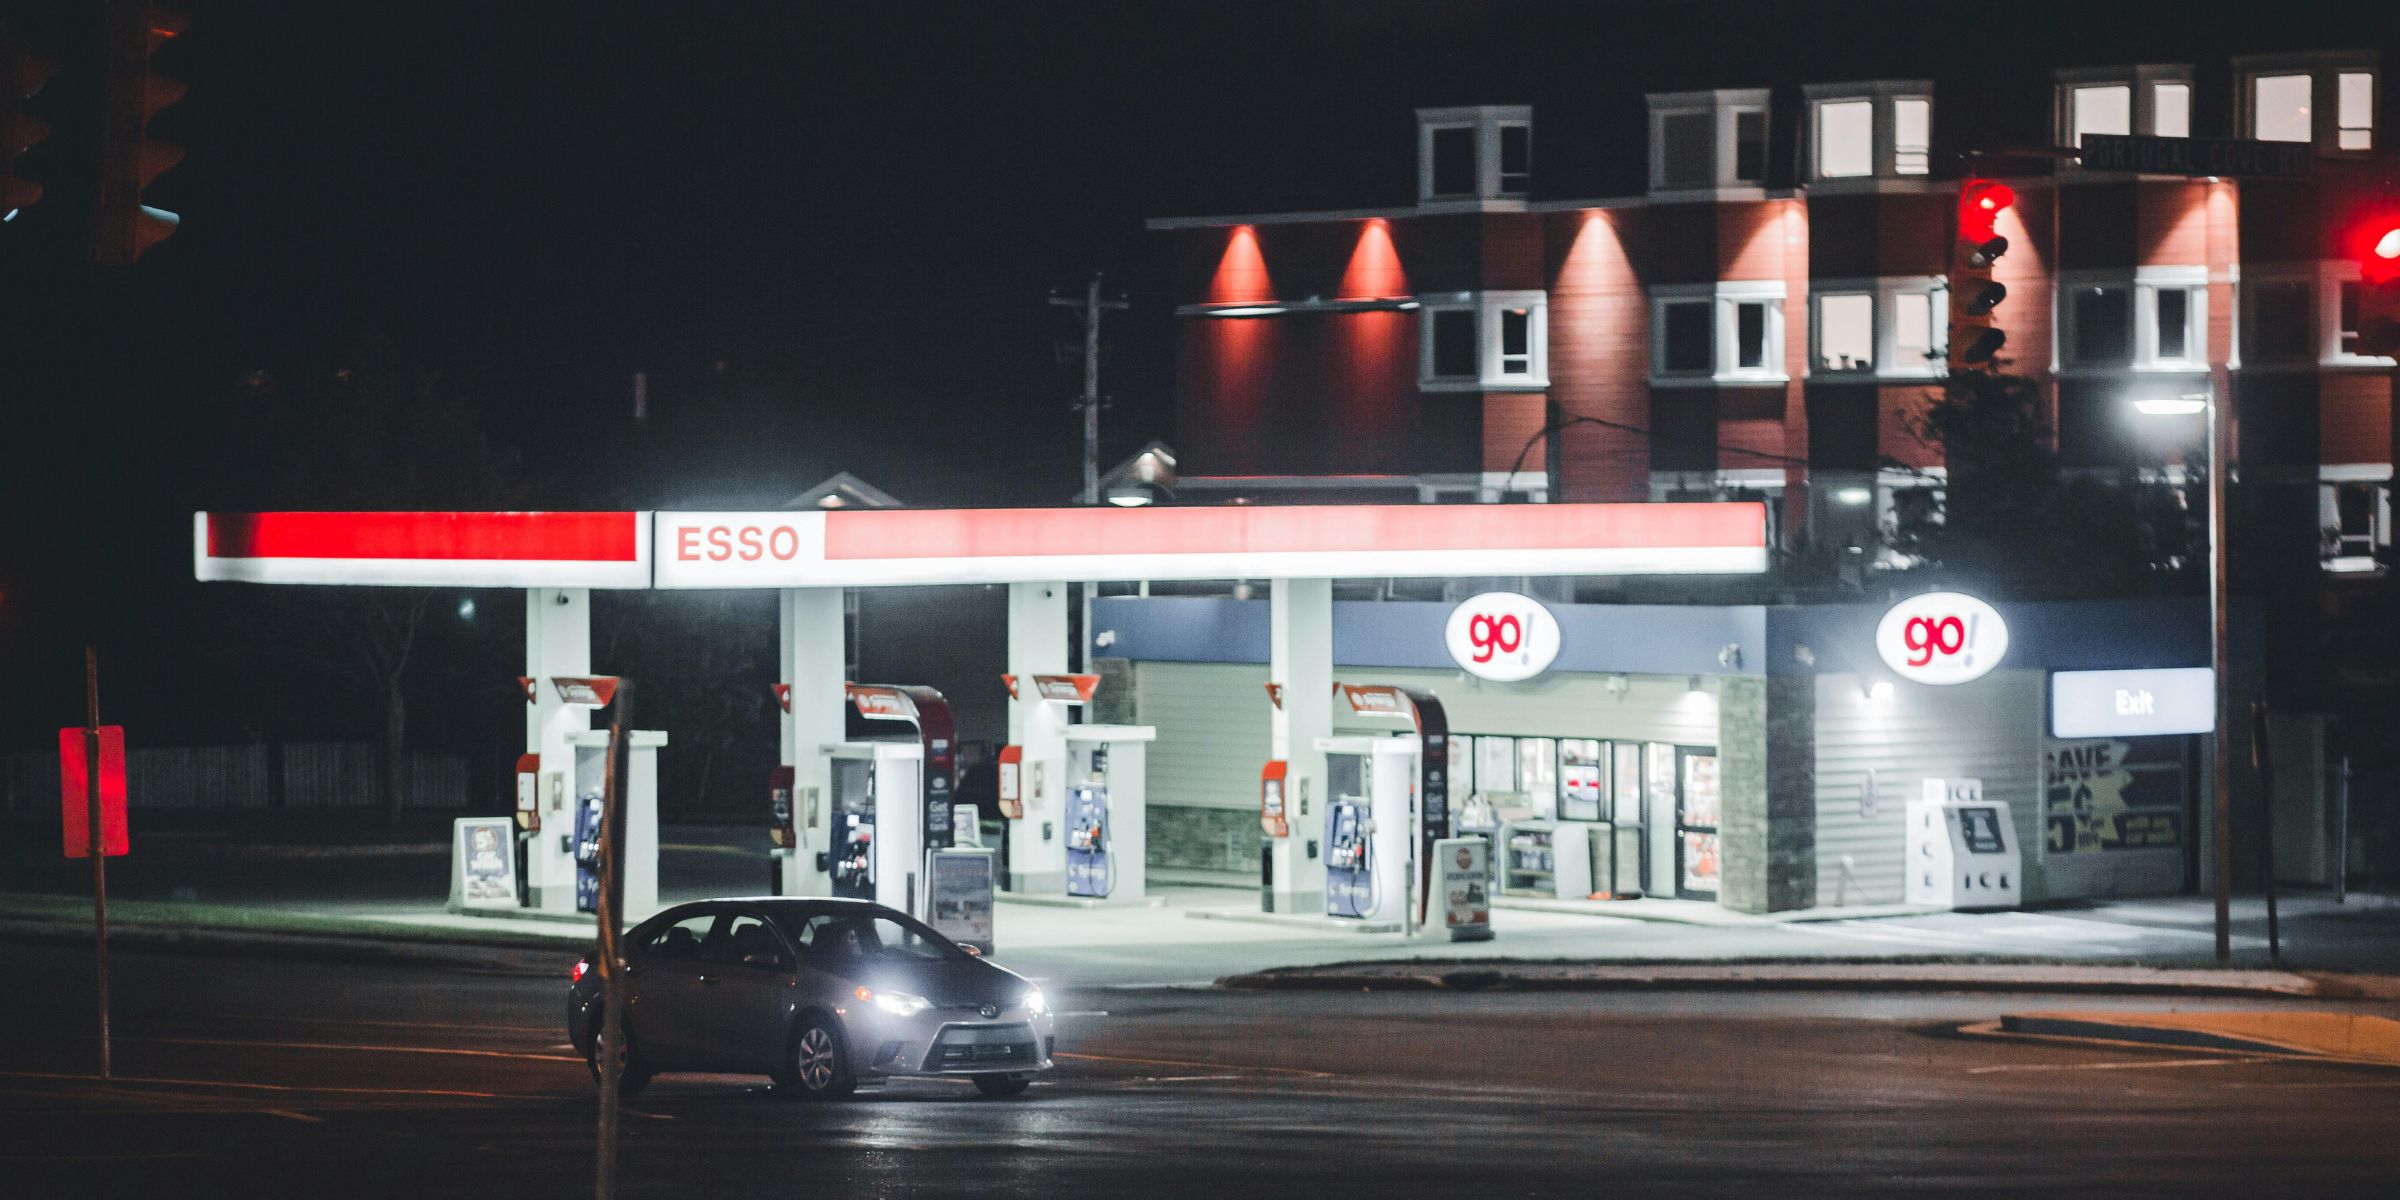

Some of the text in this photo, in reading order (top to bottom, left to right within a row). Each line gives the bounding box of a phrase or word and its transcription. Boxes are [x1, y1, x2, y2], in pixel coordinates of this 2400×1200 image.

[2083, 138, 2305, 175] PORTUGAL COVE RD
[677, 525, 800, 562] ESSO
[1469, 612, 1535, 666] go!
[1904, 612, 1980, 668] go!
[2115, 688, 2155, 716] Exit
